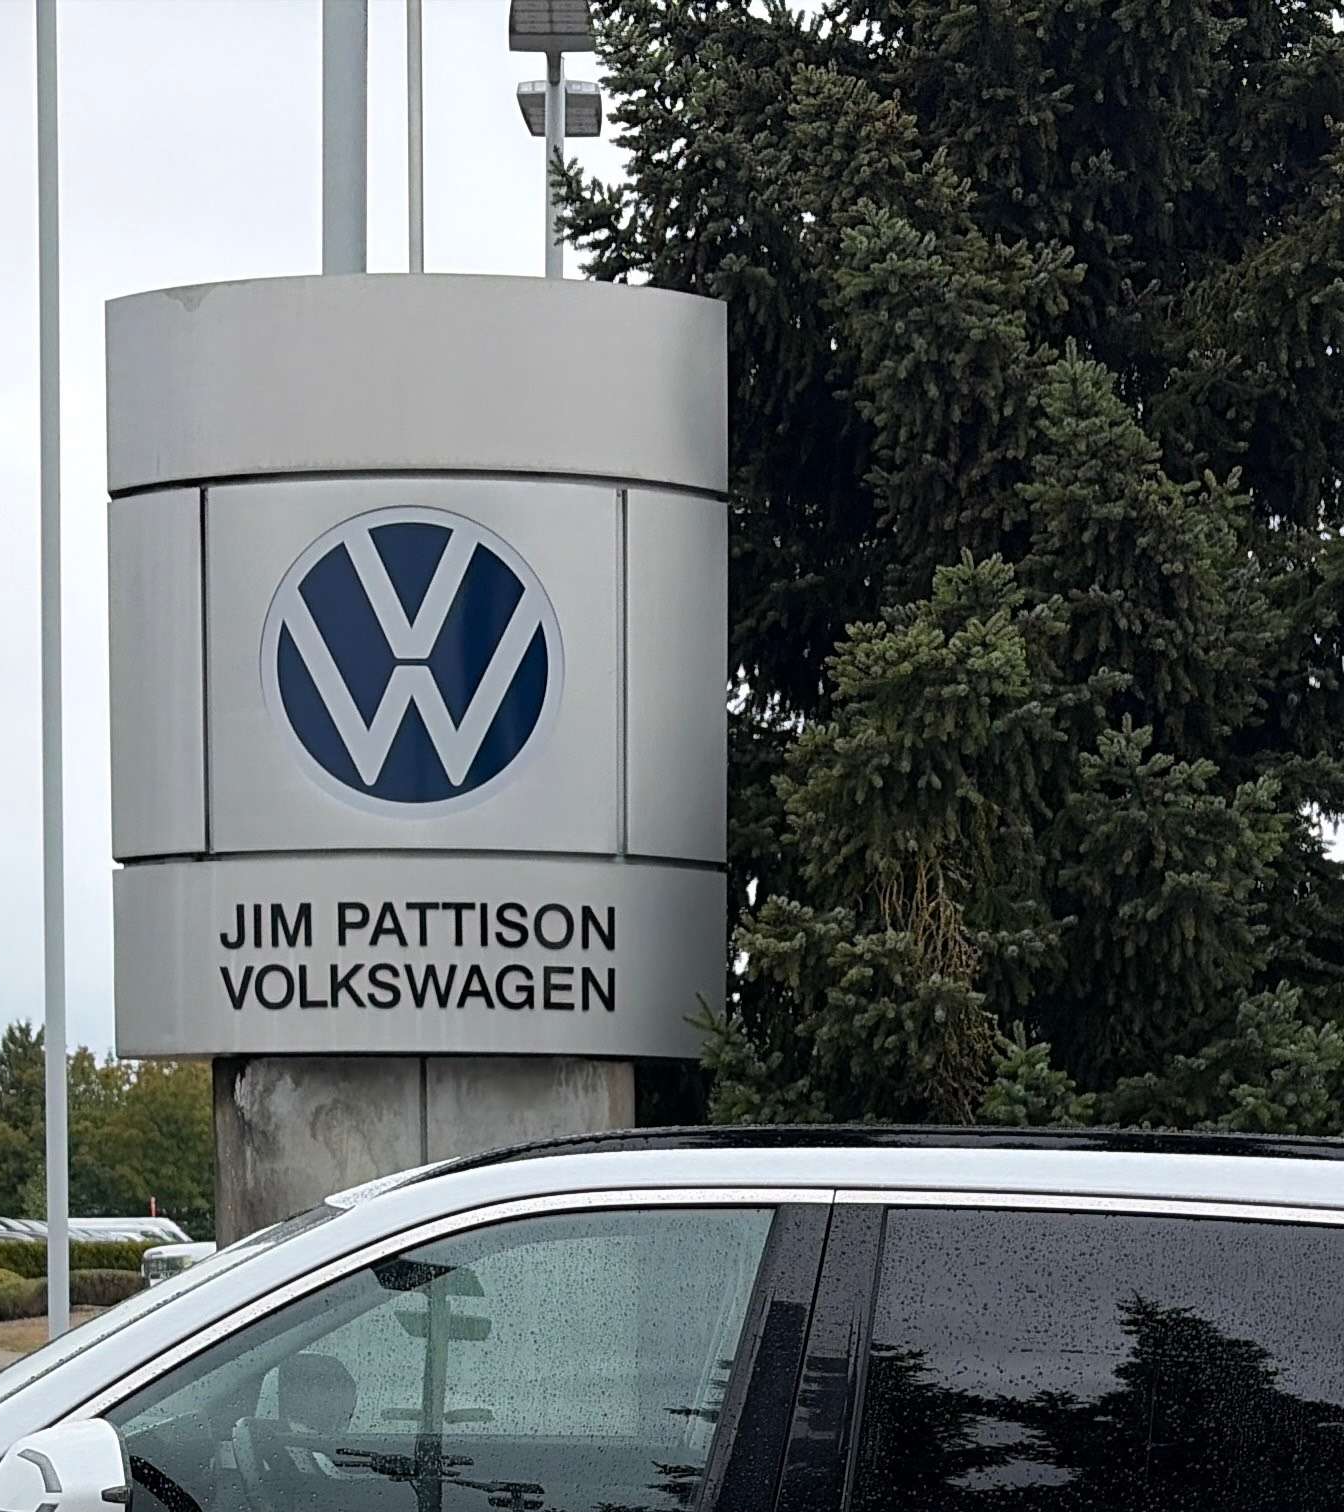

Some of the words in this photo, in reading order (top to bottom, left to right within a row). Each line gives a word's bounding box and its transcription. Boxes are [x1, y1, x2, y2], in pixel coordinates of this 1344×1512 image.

[273, 517, 553, 806] VW
[220, 902, 312, 951] JIM
[337, 901, 616, 952] PATTISON
[220, 963, 616, 1012] VOLKSWAGEN
